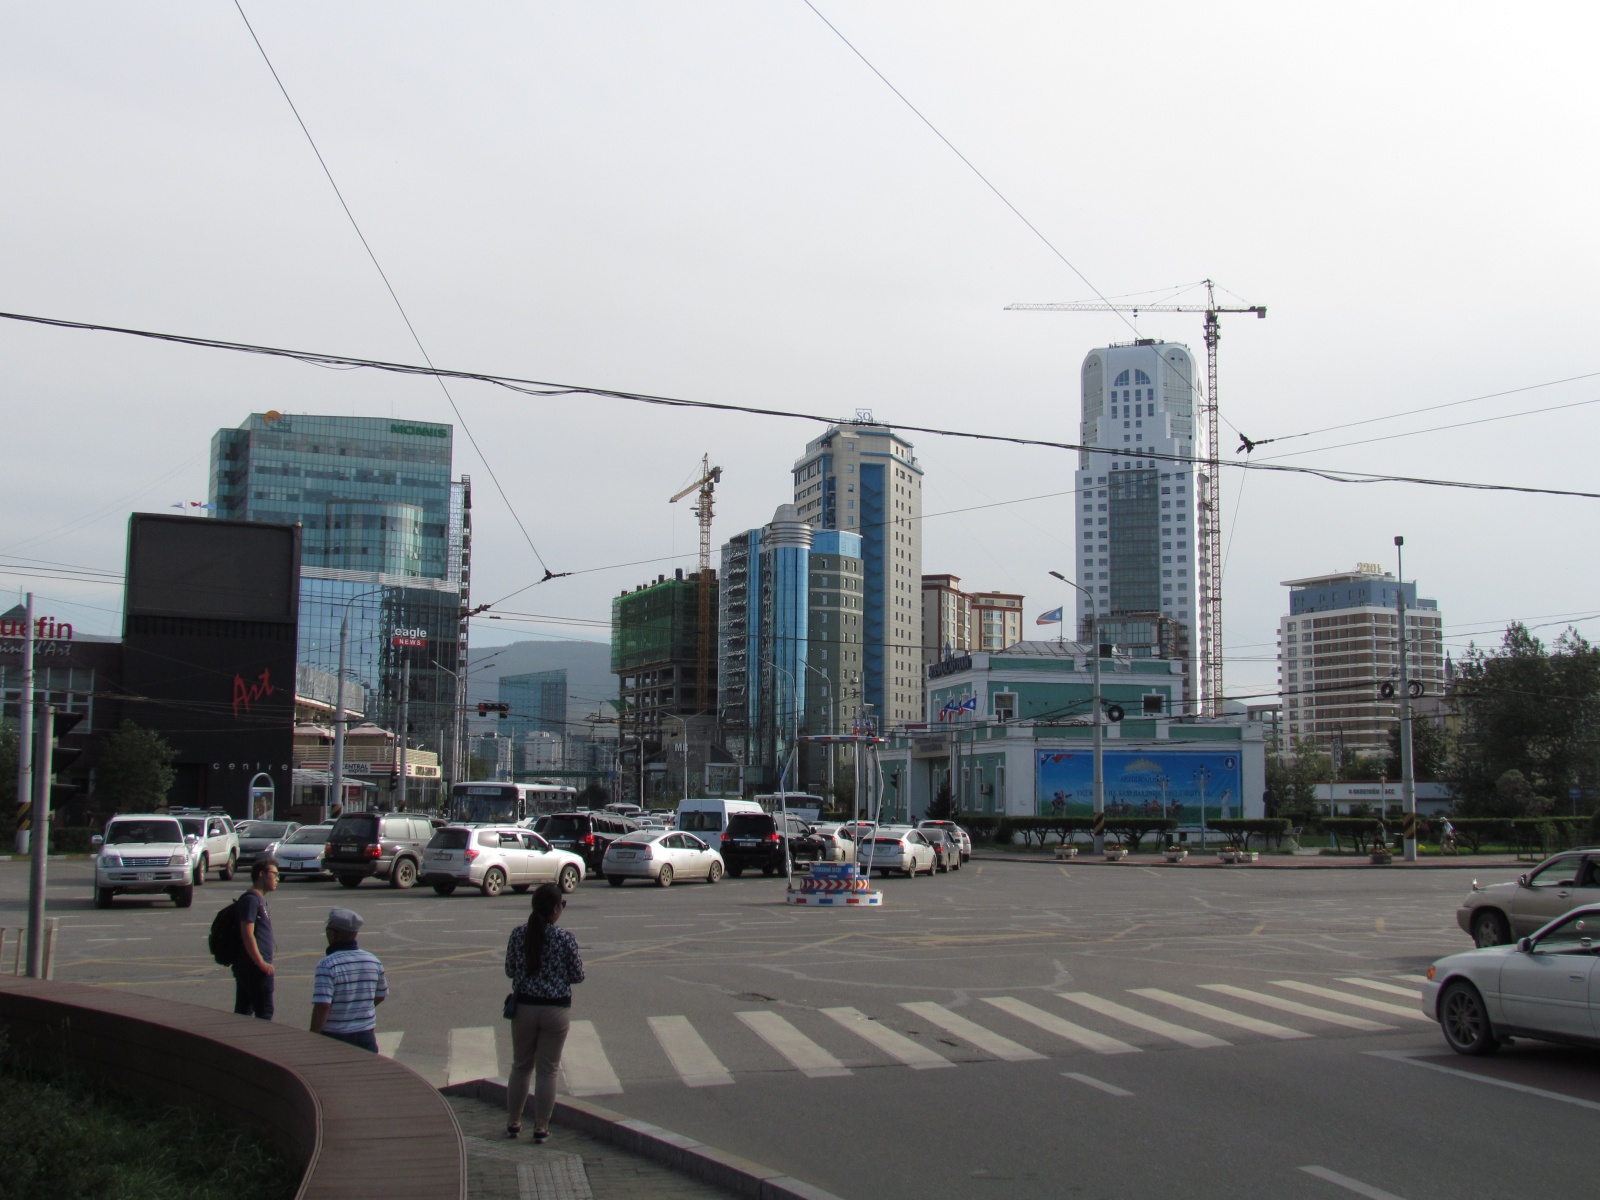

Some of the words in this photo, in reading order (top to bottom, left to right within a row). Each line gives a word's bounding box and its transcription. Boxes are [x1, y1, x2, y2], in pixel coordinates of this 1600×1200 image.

[391, 424, 447, 438] MONNIS
[395, 628, 427, 639] eagle
[233, 667, 275, 719] Art
[213, 761, 288, 771] centre
